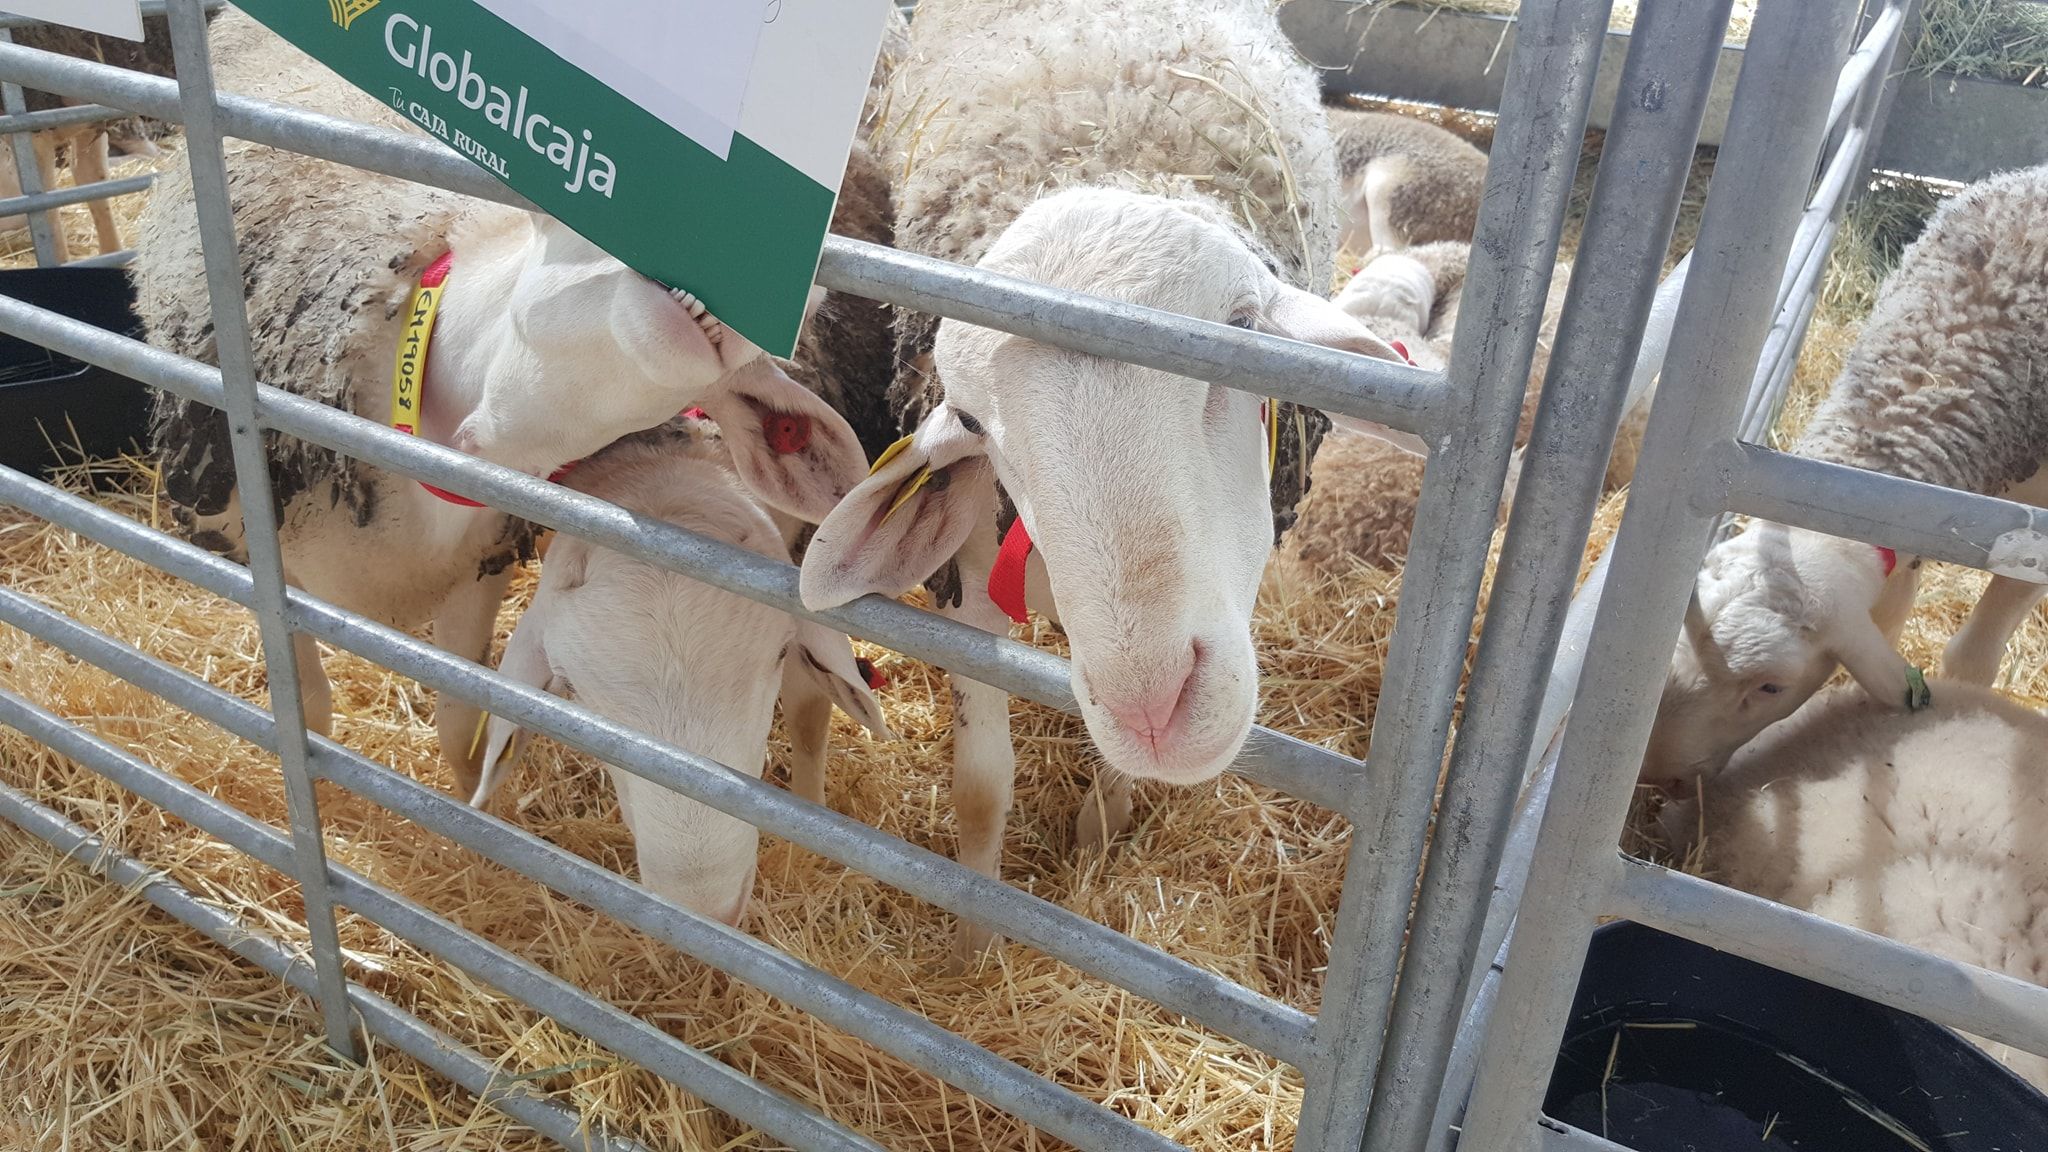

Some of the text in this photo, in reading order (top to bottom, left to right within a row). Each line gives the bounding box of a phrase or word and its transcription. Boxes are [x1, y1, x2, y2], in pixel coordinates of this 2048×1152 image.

[384, 13, 617, 199] Globalcaja
[388, 86, 510, 180] Tu CAJA RURAL
